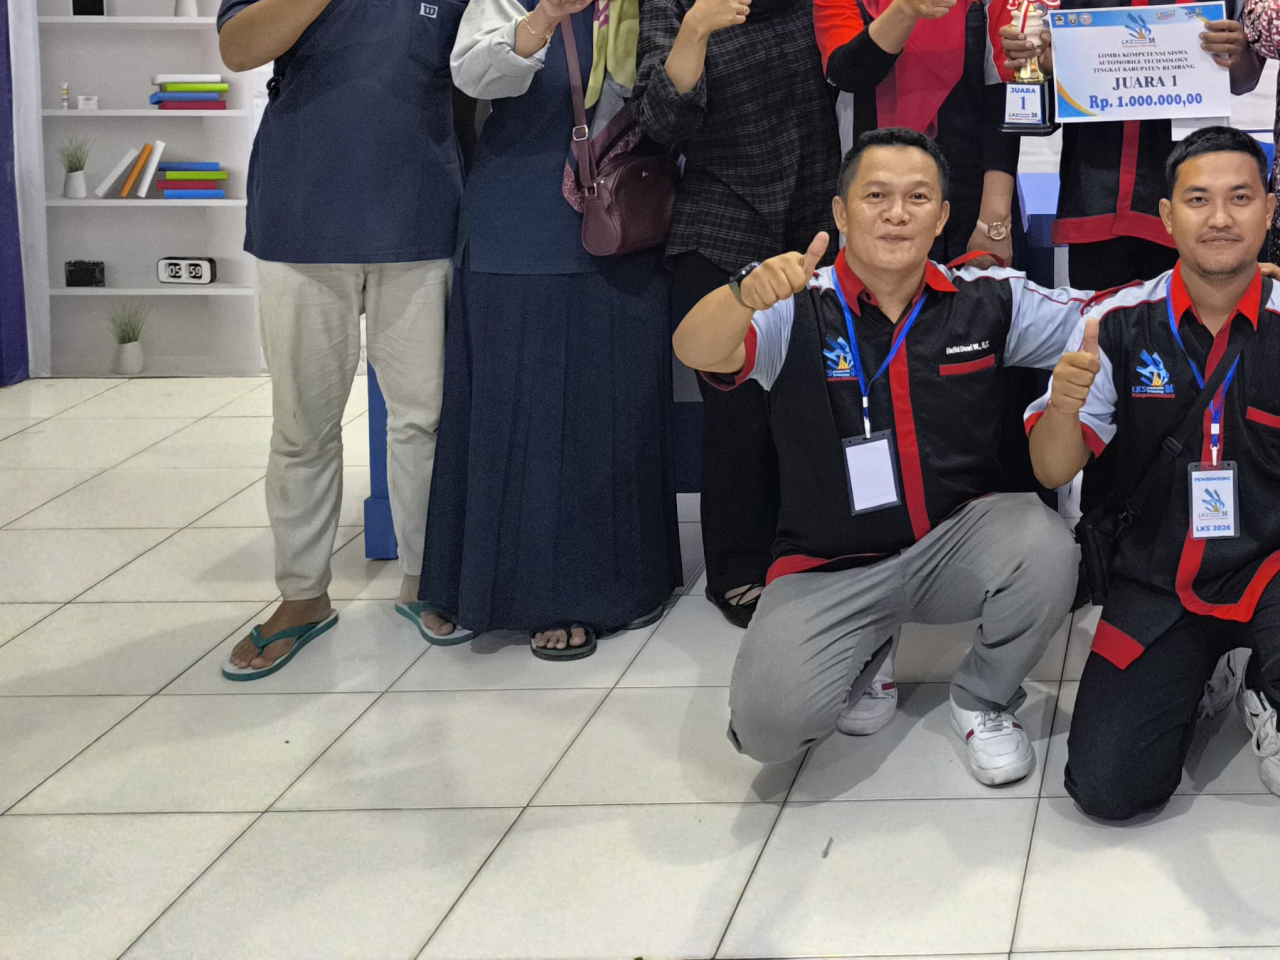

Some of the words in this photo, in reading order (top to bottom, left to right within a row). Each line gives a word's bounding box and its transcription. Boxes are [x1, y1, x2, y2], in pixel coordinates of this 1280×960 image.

[1122, 50, 1166, 58] KOMPETENSI
[1112, 75, 1166, 91] JUARA
[1171, 75, 1178, 87] 1
[1020, 96, 1026, 110] 1
[1089, 95, 1113, 111] Rp.
[1117, 93, 1203, 108] 1.000.000,00
[169, 265, 182, 277] 05
[190, 266, 202, 277] 59
[1212, 524, 1231, 532] 2026
